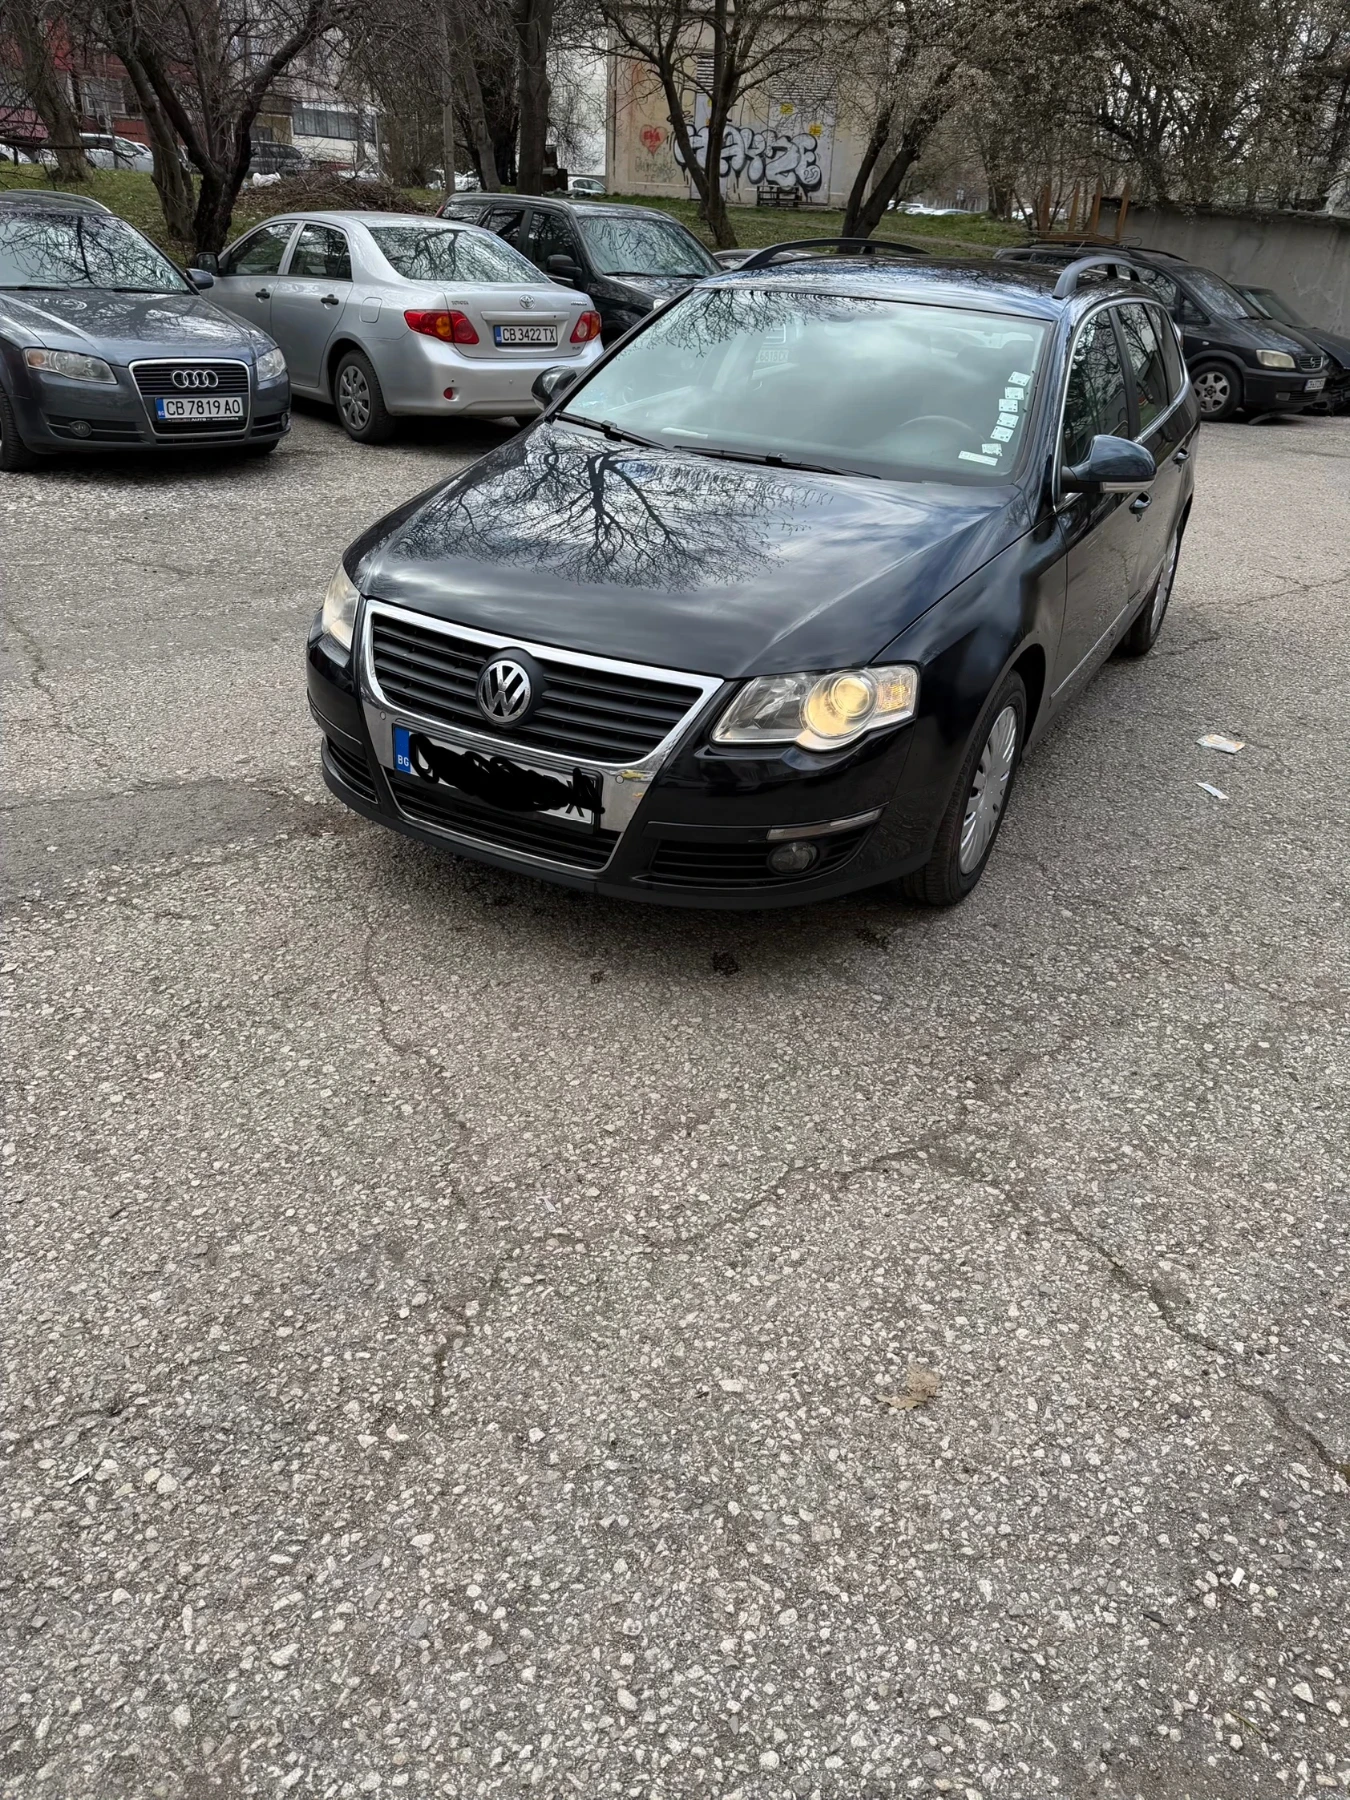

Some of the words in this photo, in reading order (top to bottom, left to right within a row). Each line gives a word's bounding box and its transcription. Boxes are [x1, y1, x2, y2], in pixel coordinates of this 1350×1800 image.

[803, 166, 819, 183] 25
[502, 328, 517, 342] CB
[518, 328, 542, 342] 3422
[544, 328, 556, 342] TX
[166, 401, 185, 416] CB
[187, 400, 221, 415] 7819
[397, 754, 410, 767] BG
